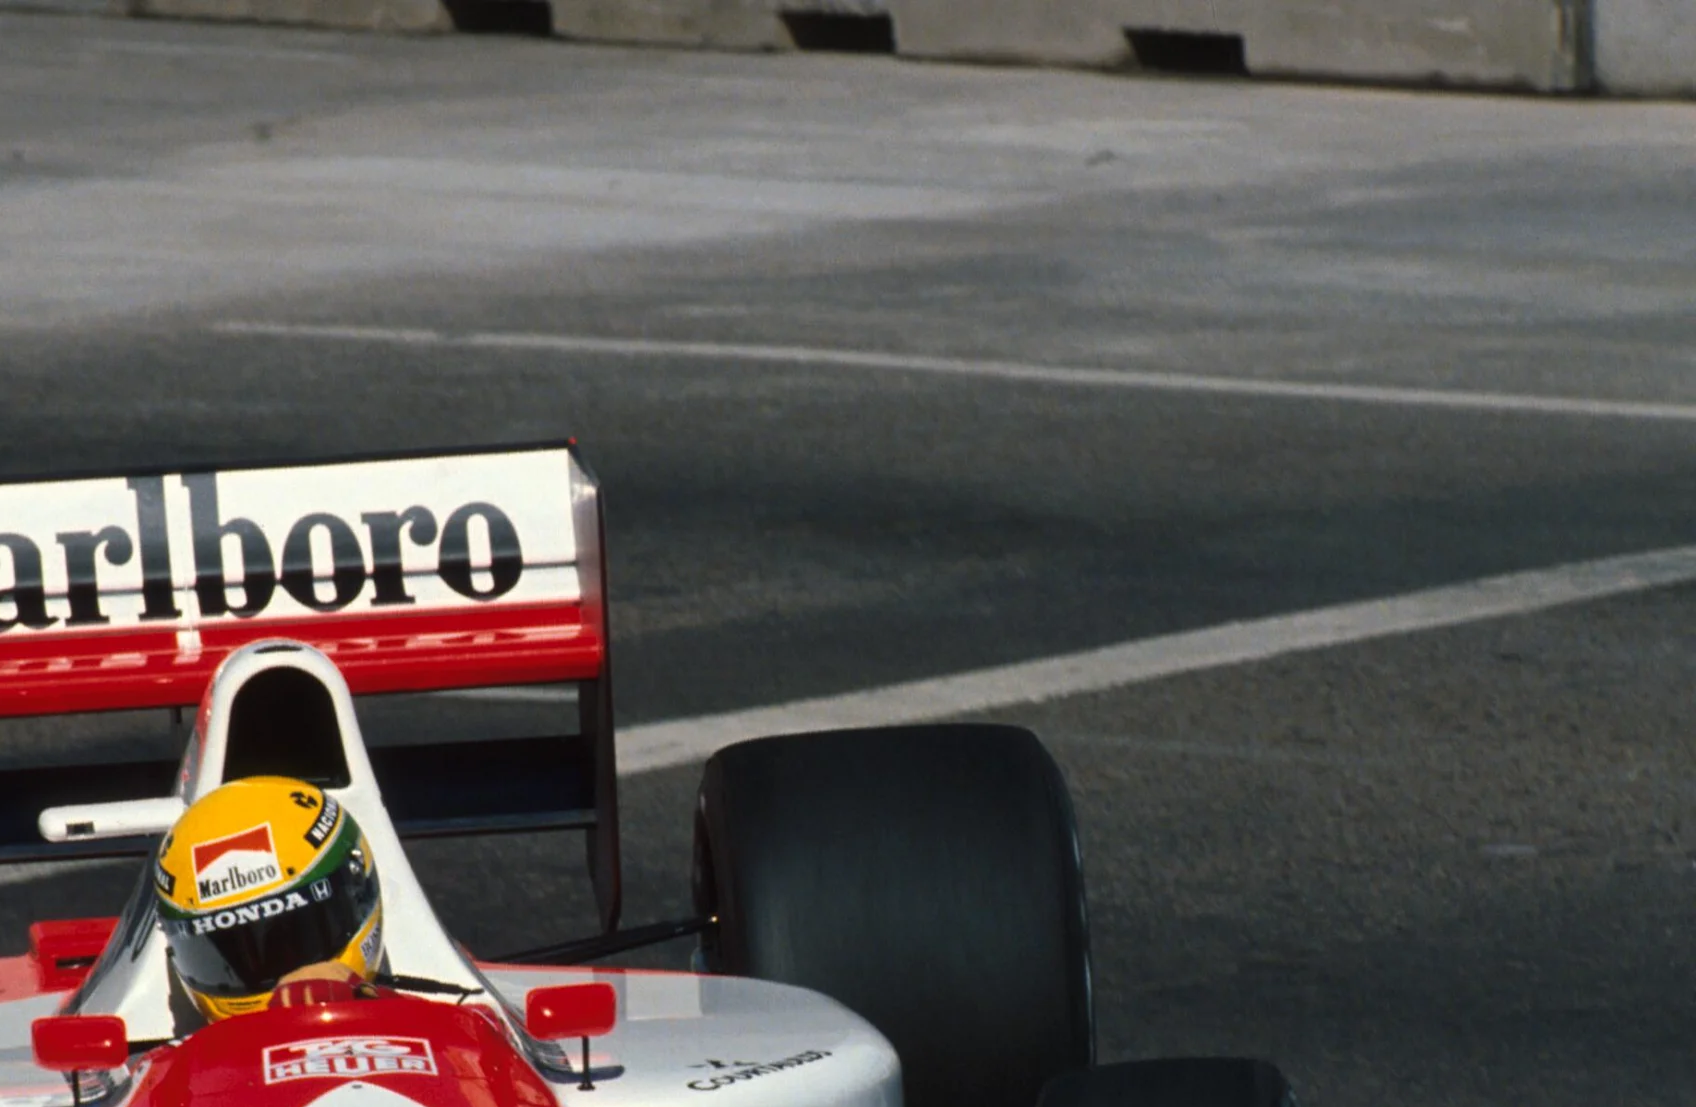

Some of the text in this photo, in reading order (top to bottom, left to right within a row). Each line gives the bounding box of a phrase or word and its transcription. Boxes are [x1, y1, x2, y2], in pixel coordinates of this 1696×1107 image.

[198, 863, 278, 900] Marlboro
[191, 891, 309, 936] HONDA
[272, 1056, 426, 1079] HEUER
